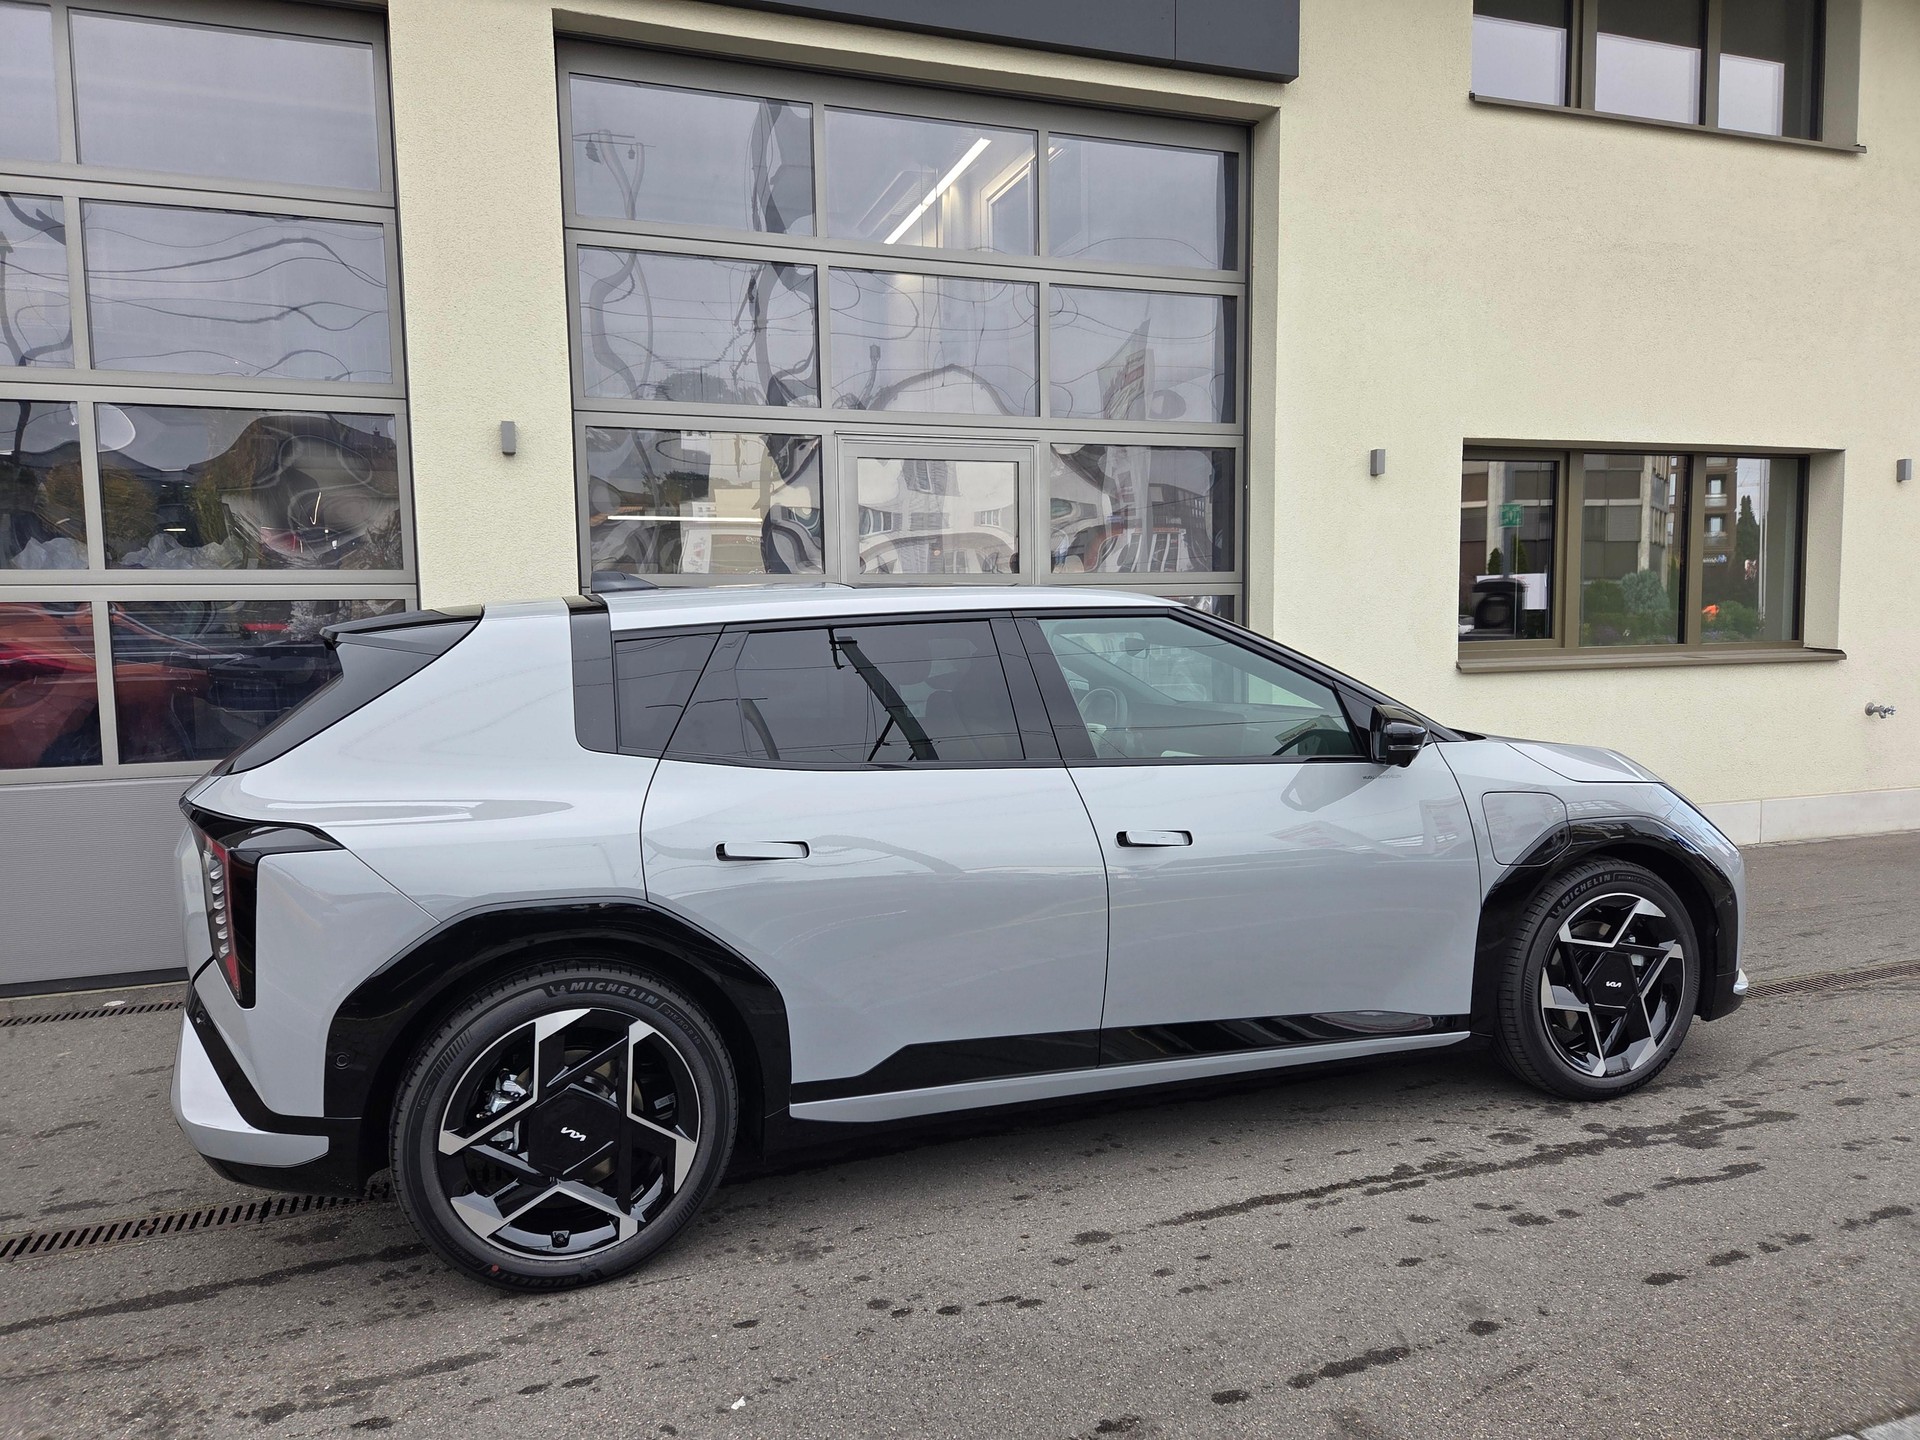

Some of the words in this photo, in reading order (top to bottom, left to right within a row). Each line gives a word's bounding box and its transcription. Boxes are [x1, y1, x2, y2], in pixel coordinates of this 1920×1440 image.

[1561, 873, 1611, 907] MICHELIN
[569, 981, 659, 1006] MICHELIN
[560, 1126, 587, 1142] KIA
[484, 1270, 579, 1288] MICHELIN
